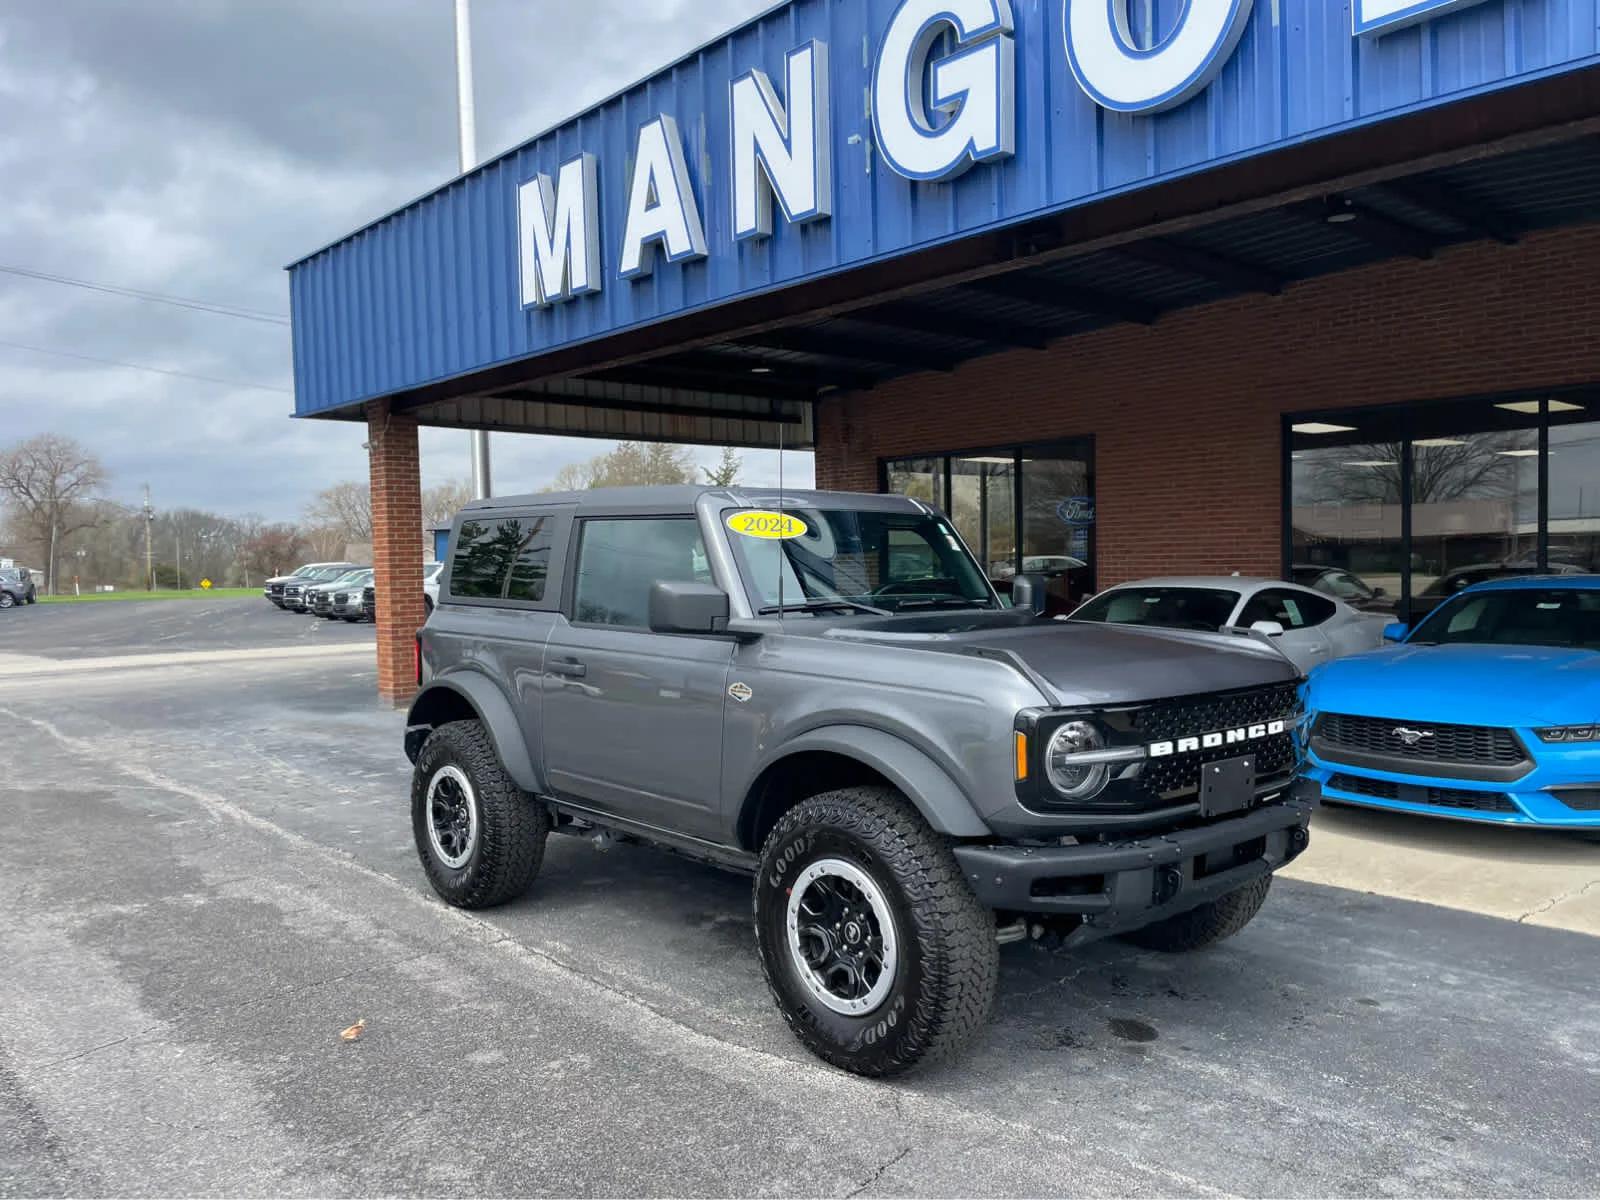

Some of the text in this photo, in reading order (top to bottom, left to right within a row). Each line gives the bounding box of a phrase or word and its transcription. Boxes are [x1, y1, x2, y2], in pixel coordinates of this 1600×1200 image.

[1064, 500, 1095, 520] Ford
[743, 516, 794, 533] 2024
[1150, 720, 1284, 757] BRONCO
